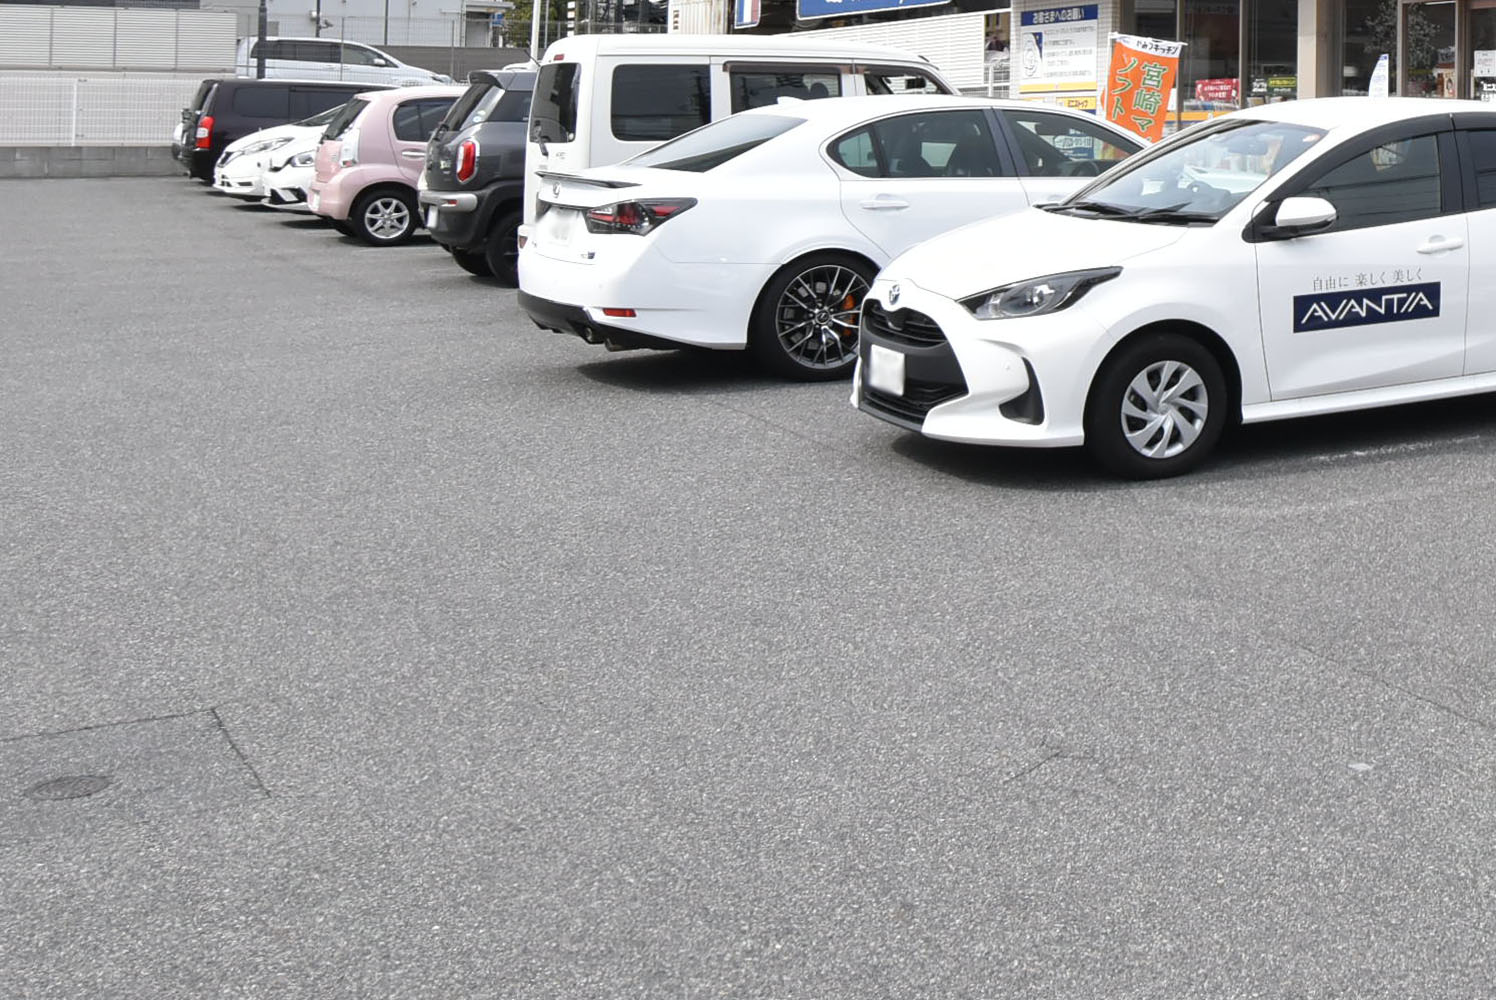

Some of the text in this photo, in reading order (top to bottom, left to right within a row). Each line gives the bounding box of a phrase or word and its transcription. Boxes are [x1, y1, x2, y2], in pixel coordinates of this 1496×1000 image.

[1112, 54, 1139, 121] ソフト
[1312, 267, 1423, 292] 自由に 楽しく 美しく
